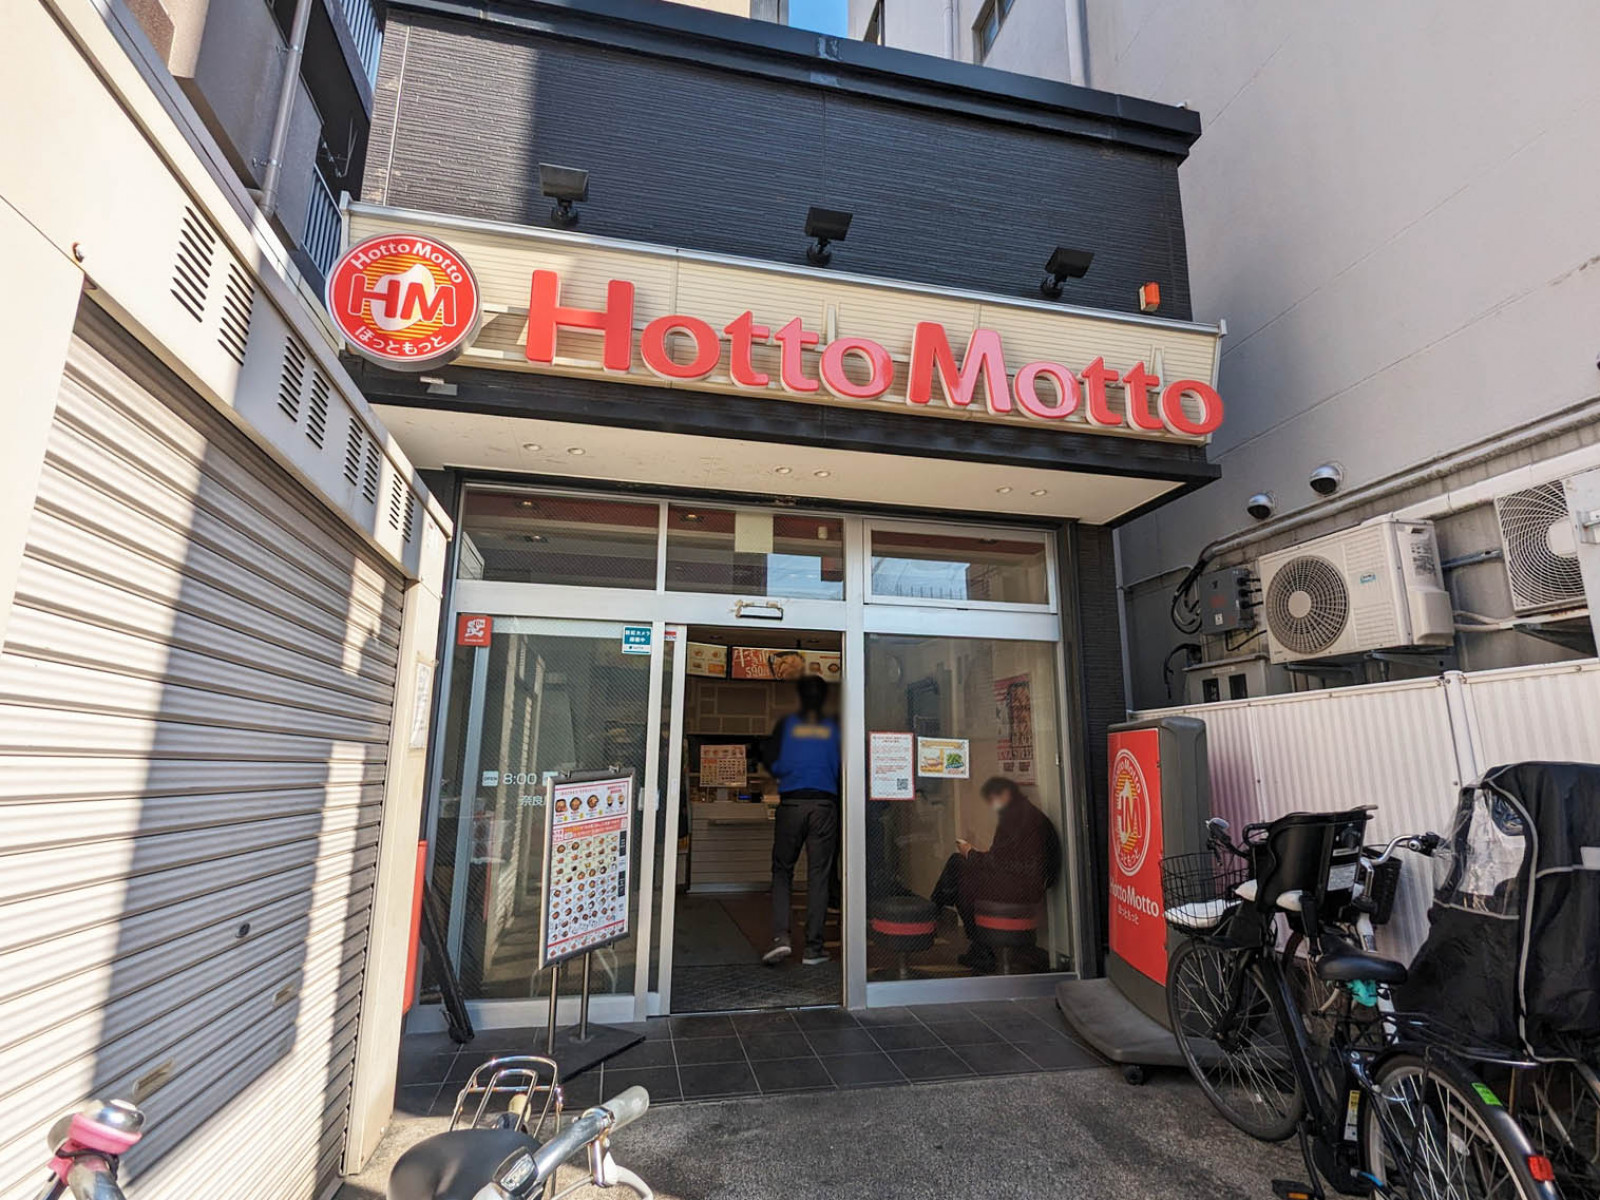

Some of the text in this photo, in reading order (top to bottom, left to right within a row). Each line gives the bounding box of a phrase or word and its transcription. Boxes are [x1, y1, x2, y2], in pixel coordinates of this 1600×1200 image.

[350, 242, 463, 283] Hotto Motto
[348, 273, 457, 327] HM
[353, 325, 447, 355] ほっともっと
[502, 773, 537, 785] 8:00
[521, 795, 546, 807] 奈良
